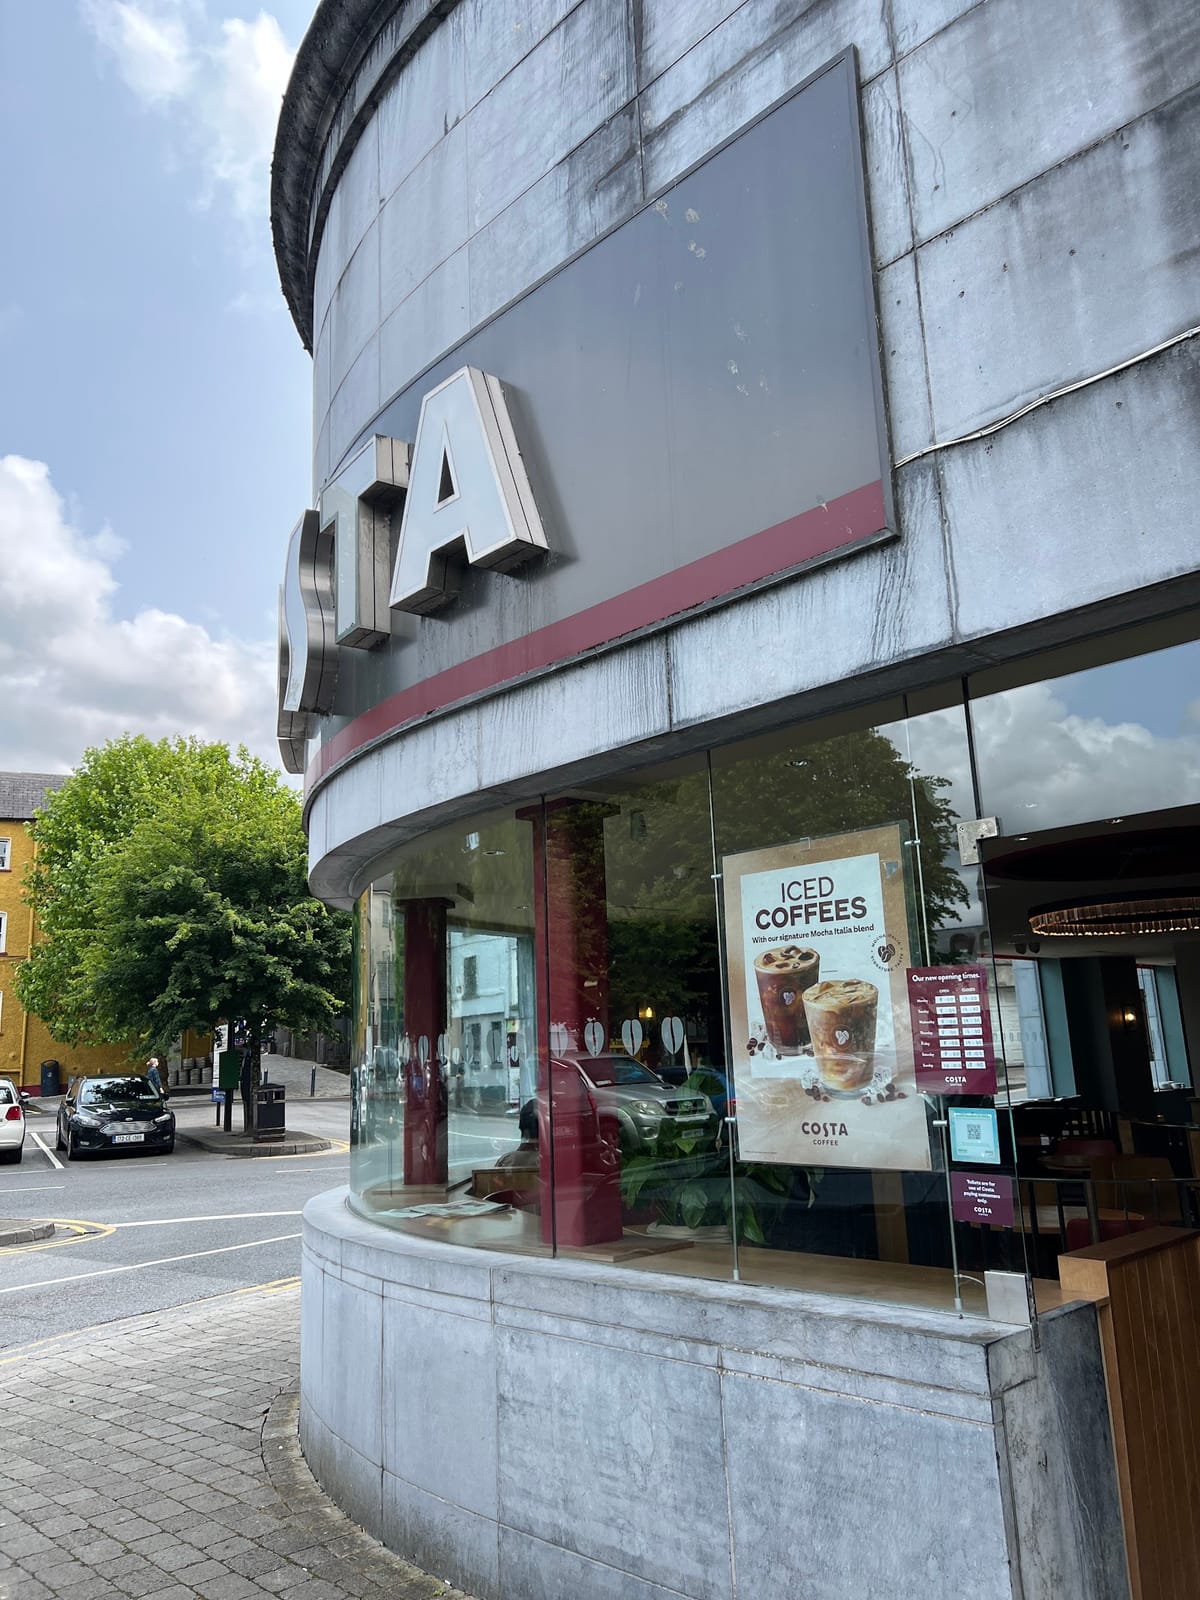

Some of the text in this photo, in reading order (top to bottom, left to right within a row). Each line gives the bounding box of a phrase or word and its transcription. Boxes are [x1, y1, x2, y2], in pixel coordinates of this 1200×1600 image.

[781, 876, 835, 903] ICED
[755, 896, 868, 930] COFFEES
[752, 923, 875, 944] With our signature Mocha Italia blend
[912, 974, 925, 982] Our
[937, 972, 962, 983] opening
[801, 1121, 849, 1137] COSTA
[973, 1206, 993, 1214] COSTA
